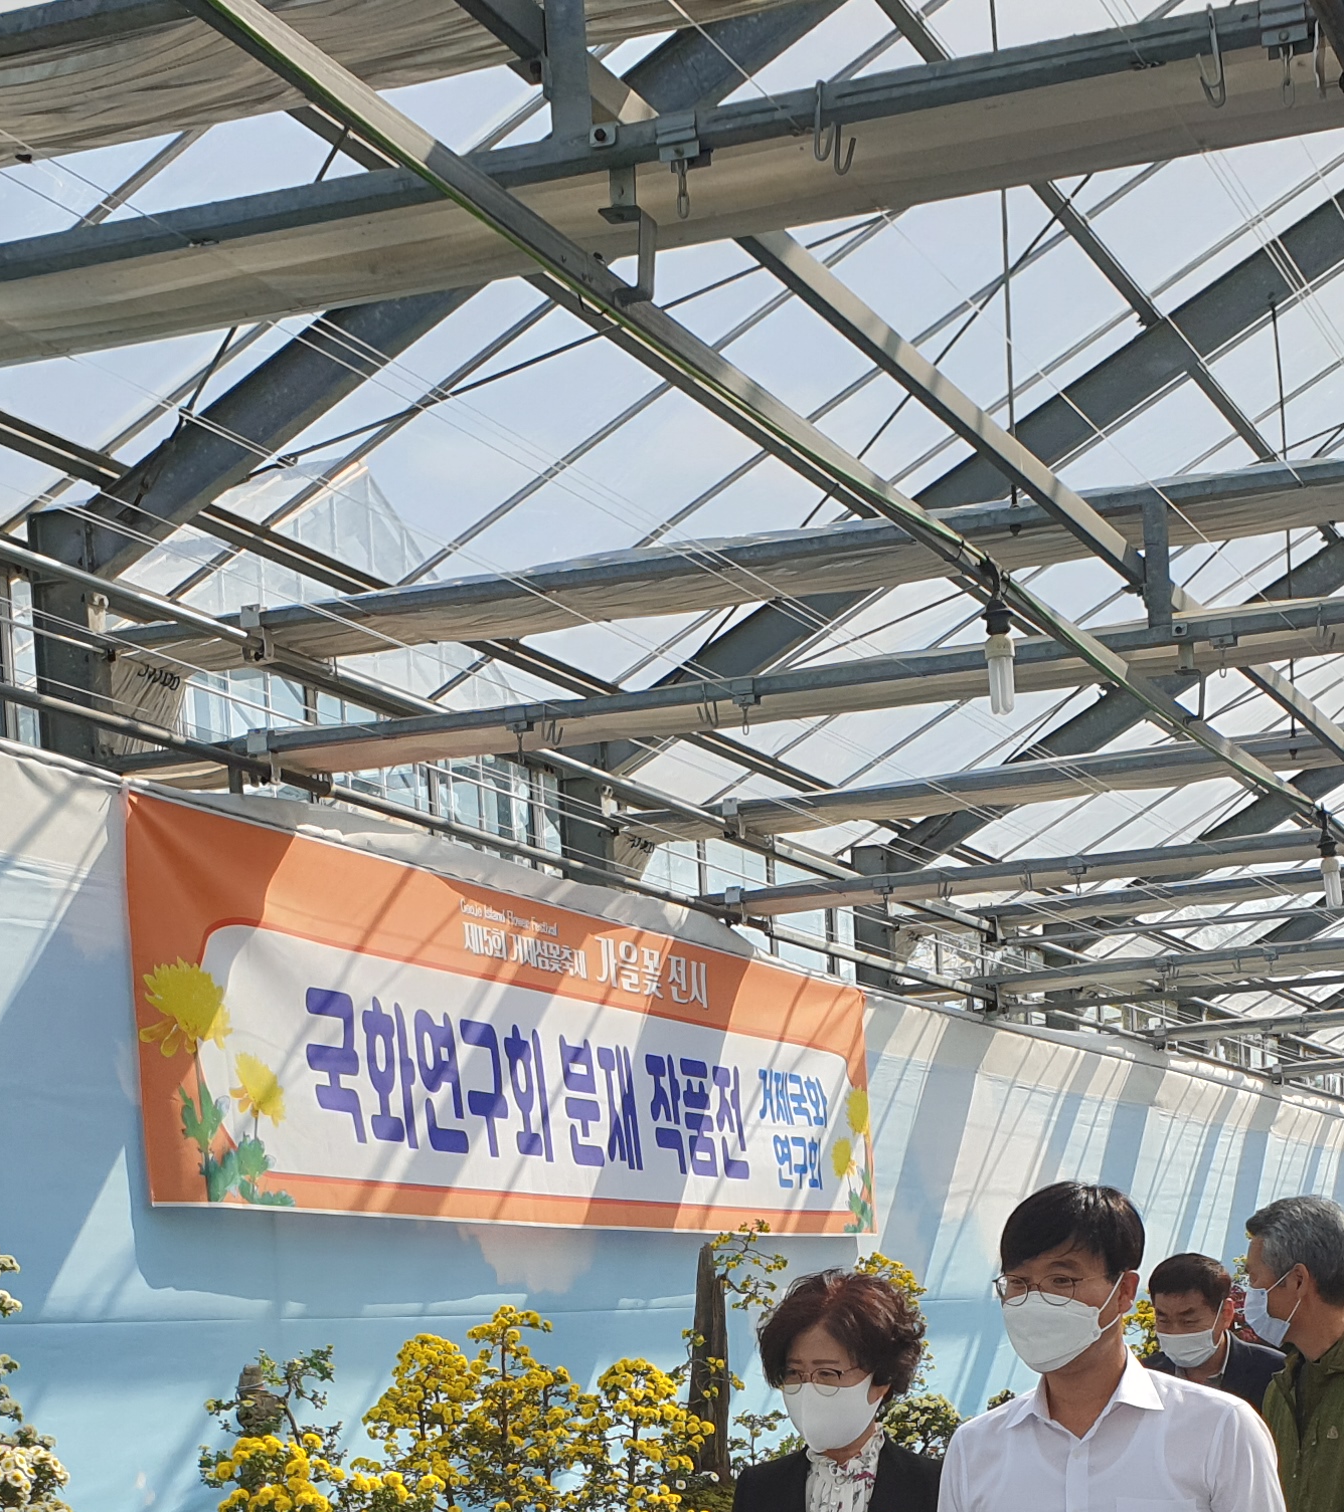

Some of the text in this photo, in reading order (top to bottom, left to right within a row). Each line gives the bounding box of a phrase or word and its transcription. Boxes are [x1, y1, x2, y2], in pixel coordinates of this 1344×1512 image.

[508, 933, 587, 979] 거제섬꽃축제
[594, 936, 664, 999] 가을꽃
[667, 954, 708, 1009] 전시
[306, 986, 750, 1180] 국화연구회 분재 작품전
[758, 1068, 828, 1129] 거제국화
[773, 1134, 823, 1191] 연구회
